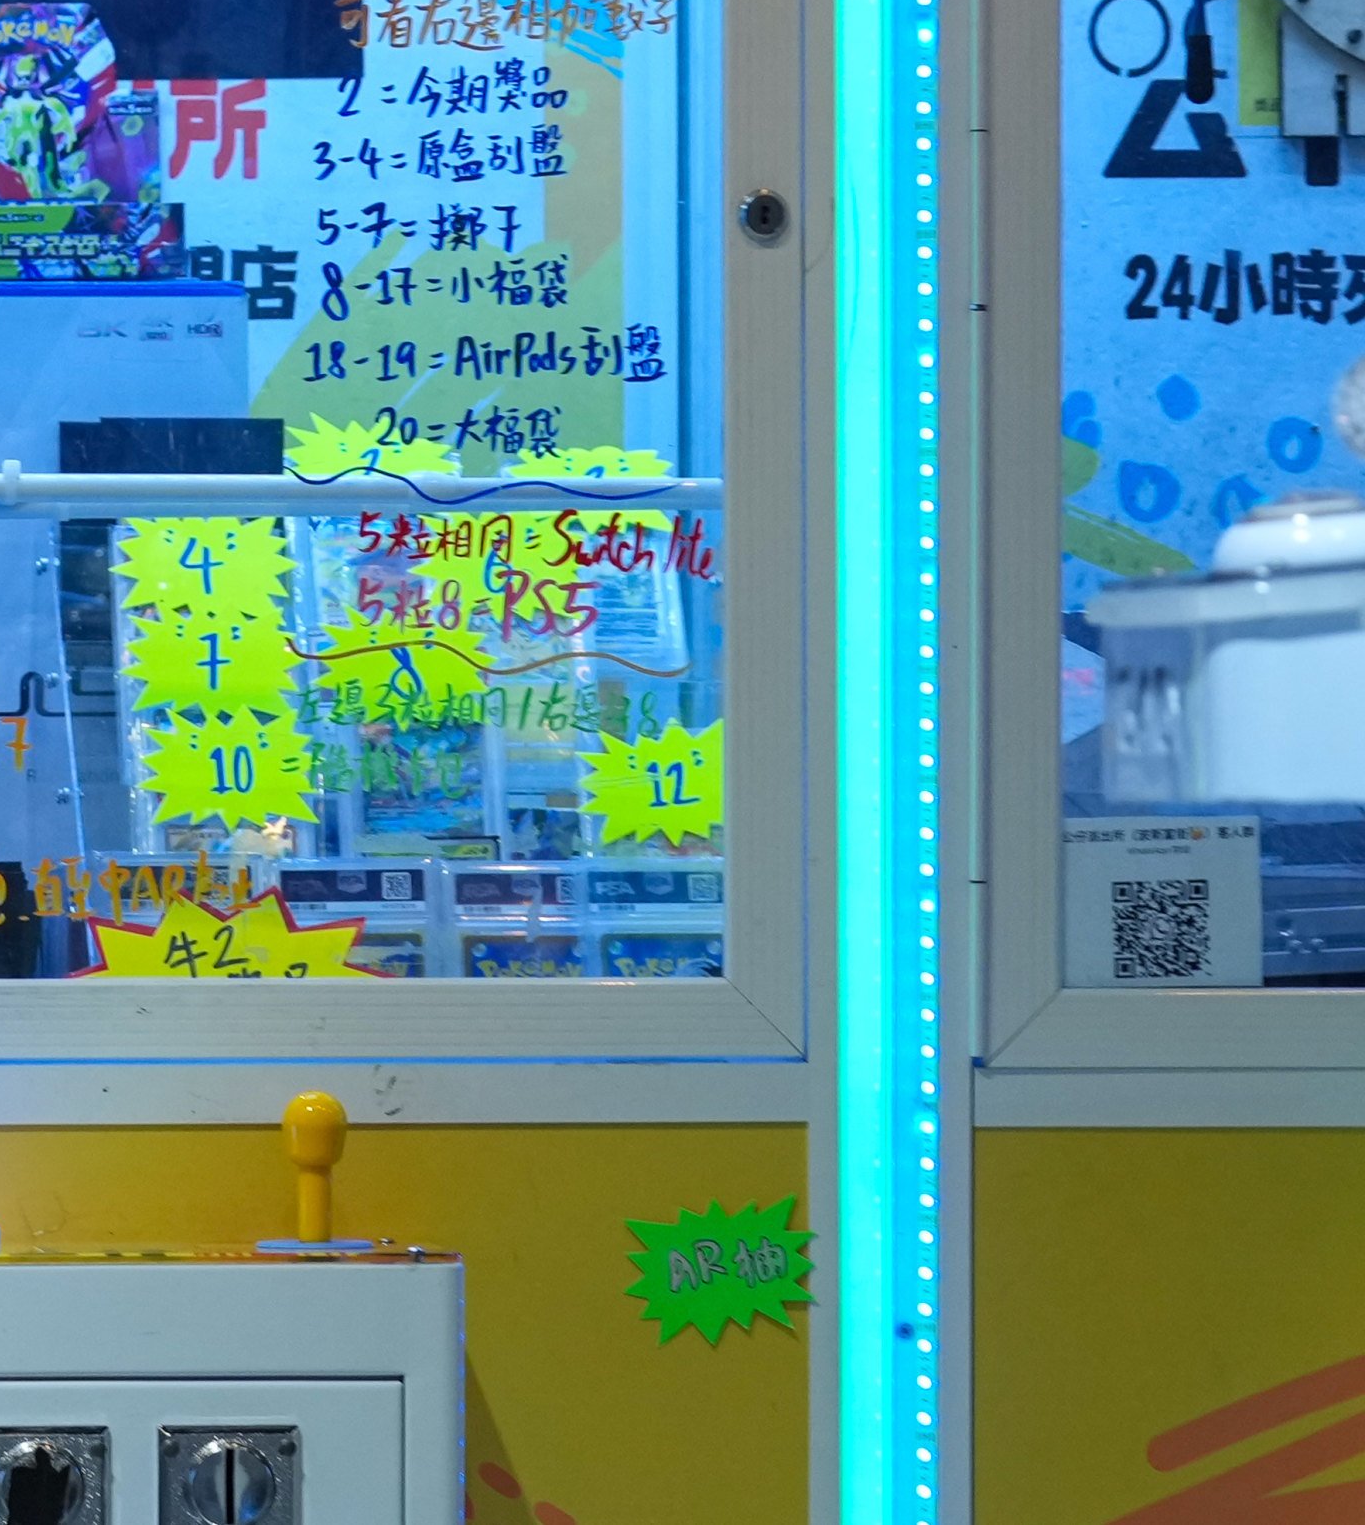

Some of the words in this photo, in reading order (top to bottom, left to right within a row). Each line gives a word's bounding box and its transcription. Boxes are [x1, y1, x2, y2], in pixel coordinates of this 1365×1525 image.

[180, 537, 225, 595] 4
[209, 745, 255, 795] 10
[647, 760, 703, 807] 12
